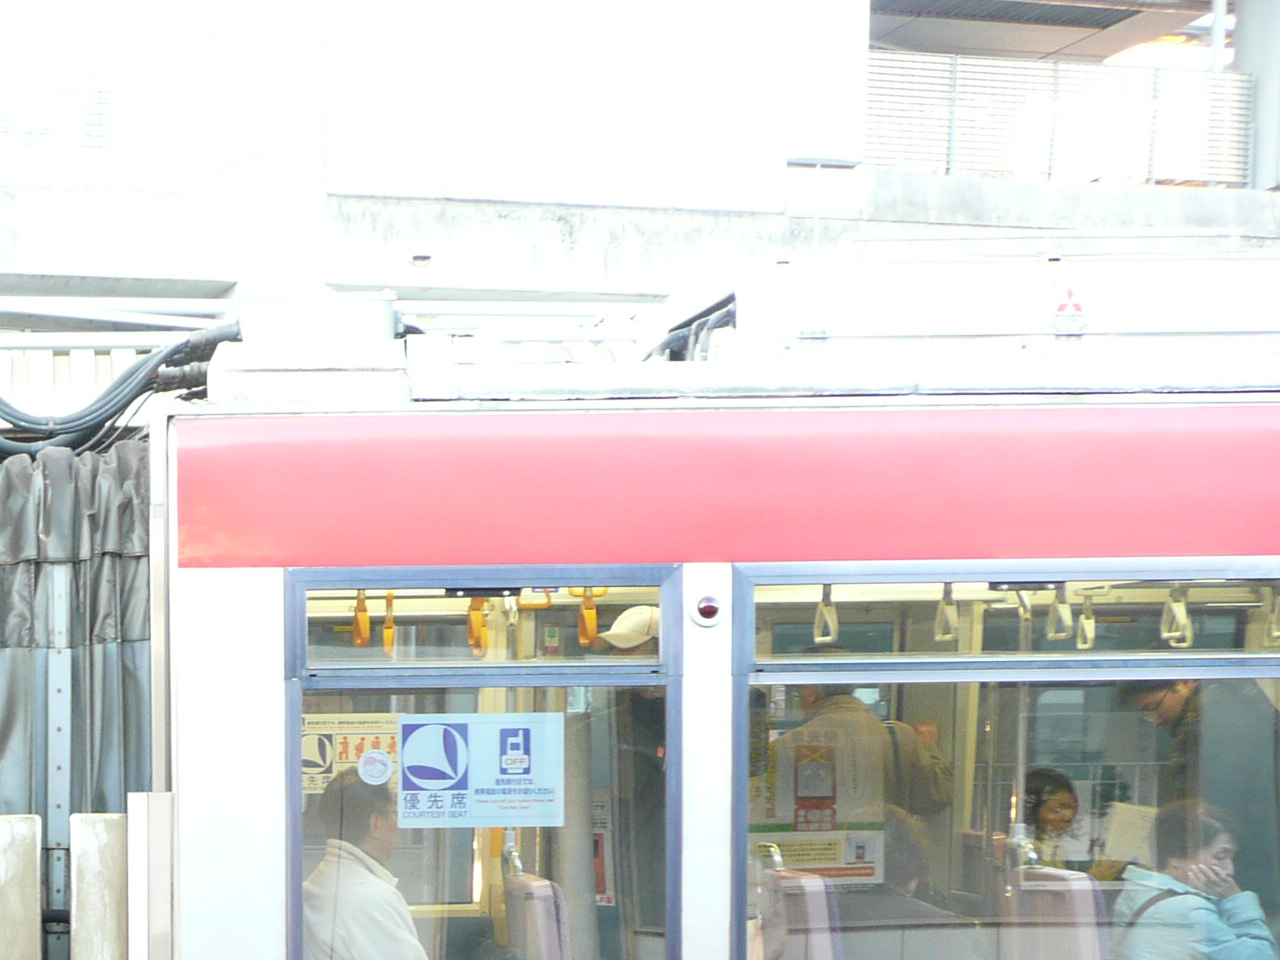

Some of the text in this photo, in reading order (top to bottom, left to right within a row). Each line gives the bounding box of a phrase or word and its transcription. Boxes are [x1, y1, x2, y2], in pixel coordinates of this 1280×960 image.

[505, 758, 527, 766] OFF
[403, 792, 468, 810] 優先席
[402, 810, 468, 819] COURTESY SEAT
